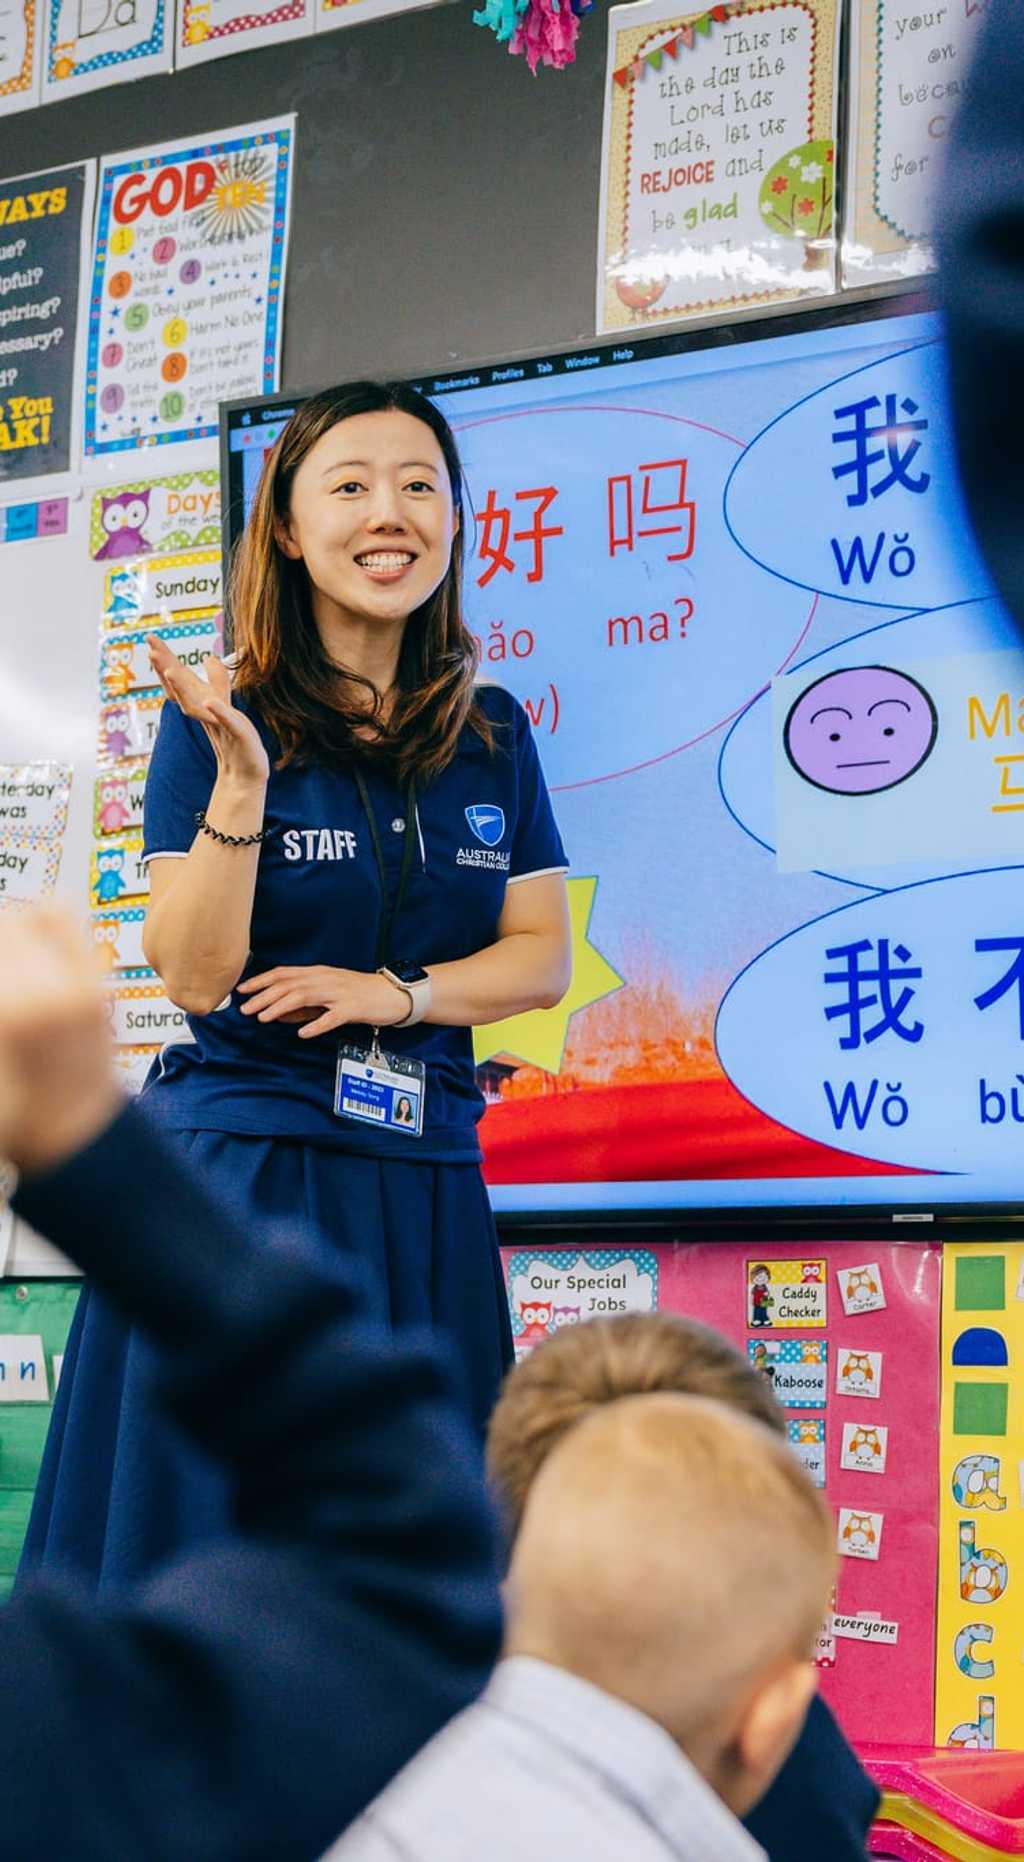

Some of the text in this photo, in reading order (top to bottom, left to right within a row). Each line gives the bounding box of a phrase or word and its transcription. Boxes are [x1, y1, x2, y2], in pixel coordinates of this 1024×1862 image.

[724, 25, 798, 56] This is
[658, 56, 785, 99] the day the
[670, 89, 775, 126] Lord has
[726, 122, 751, 144] let
[760, 117, 787, 138] us
[640, 148, 766, 195] REJOICE and
[651, 192, 739, 234] be glad
[433, 374, 481, 392] Bookmarks
[492, 366, 525, 382] Profiles
[536, 362, 553, 374] Tab
[565, 354, 601, 370] Window
[612, 348, 635, 361] Help
[7, 395, 54, 421] You
[162, 394, 182, 419] 10
[831, 393, 931, 508] 我
[474, 458, 696, 588] 好 吗
[155, 576, 220, 599] Sunday
[607, 596, 695, 647] ma?
[282, 828, 358, 862] STAFF
[456, 858, 496, 870] CHRISTIAN
[823, 937, 925, 1051] 我
[530, 1272, 627, 1293] Our Special
[782, 1287, 818, 1303] Caddy
[587, 1297, 627, 1312] Jobs
[778, 1305, 822, 1319] Checker
[774, 1373, 824, 1390] Kaboose
[952, 1454, 1007, 1509] a
[958, 1519, 1009, 1604] b
[833, 1616, 897, 1639] everyone
[953, 1622, 996, 1680] c
